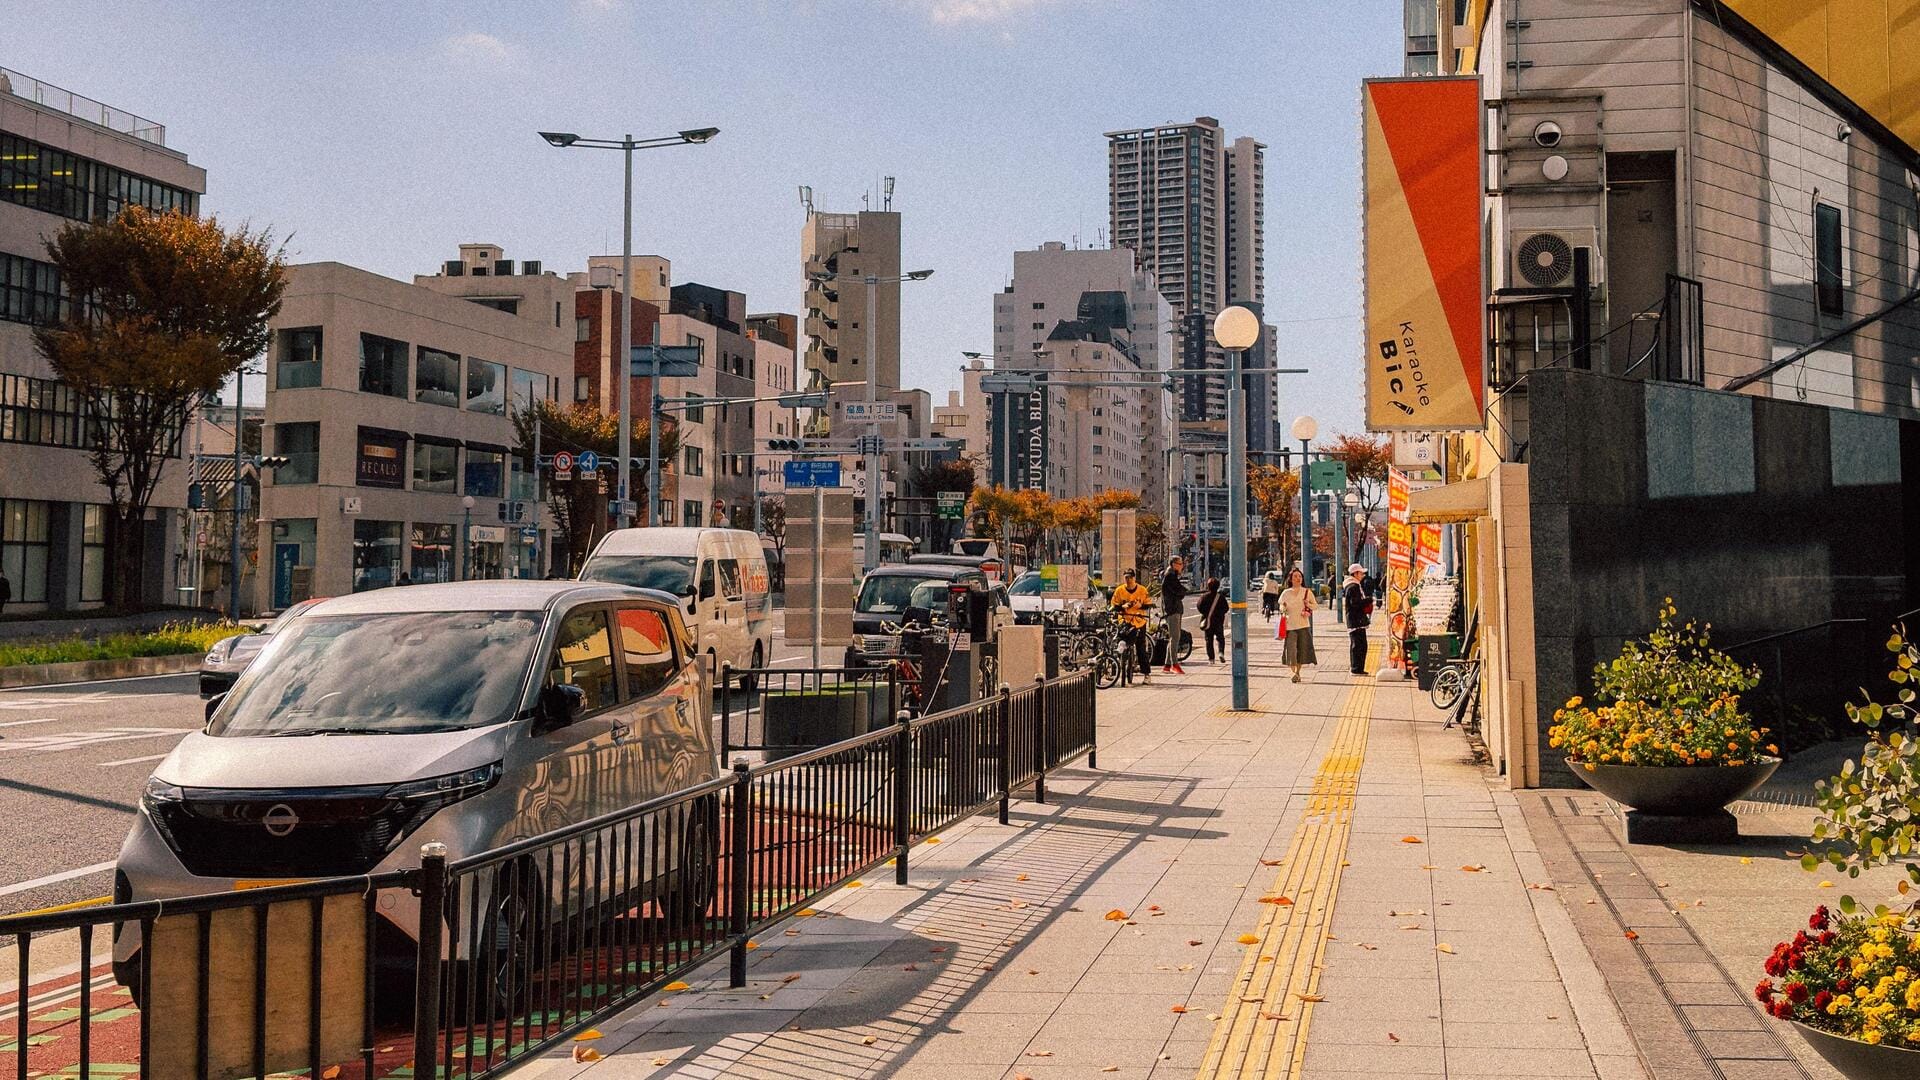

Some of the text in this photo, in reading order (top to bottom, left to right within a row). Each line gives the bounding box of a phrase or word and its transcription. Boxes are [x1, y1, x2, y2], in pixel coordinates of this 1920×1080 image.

[1379, 339, 1405, 394] Bic
[1399, 321, 1430, 407] Karaoke
[361, 461, 397, 476] RECALO
[1029, 386, 1042, 492] FUKUDA BLD.
